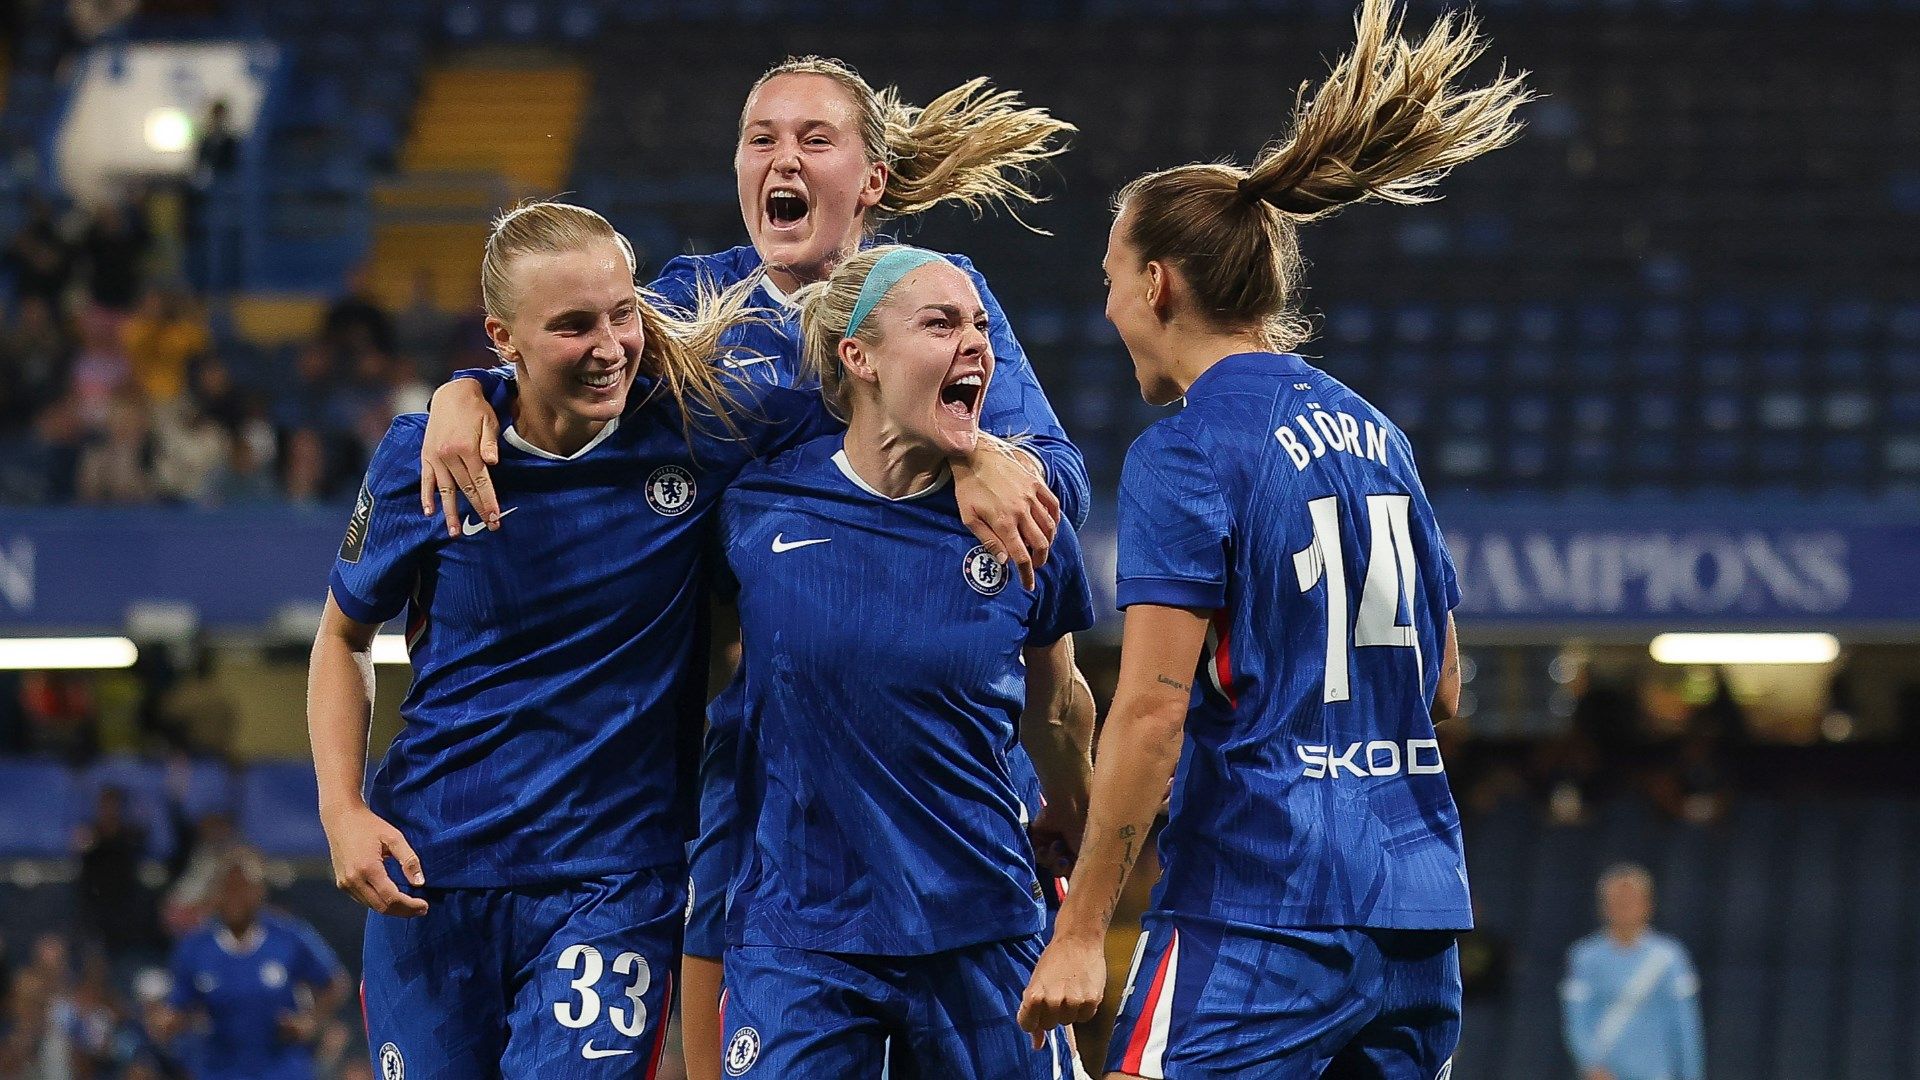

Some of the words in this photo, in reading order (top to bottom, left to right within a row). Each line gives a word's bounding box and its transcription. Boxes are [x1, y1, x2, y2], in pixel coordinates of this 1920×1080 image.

[1293, 382, 1312, 391] CFC
[1274, 402, 1388, 472] BJÖRN
[1292, 495, 1424, 703] 14
[1447, 532, 1850, 612] AMPIONS
[1296, 738, 1445, 779] SKOD
[553, 944, 651, 1037] 33
